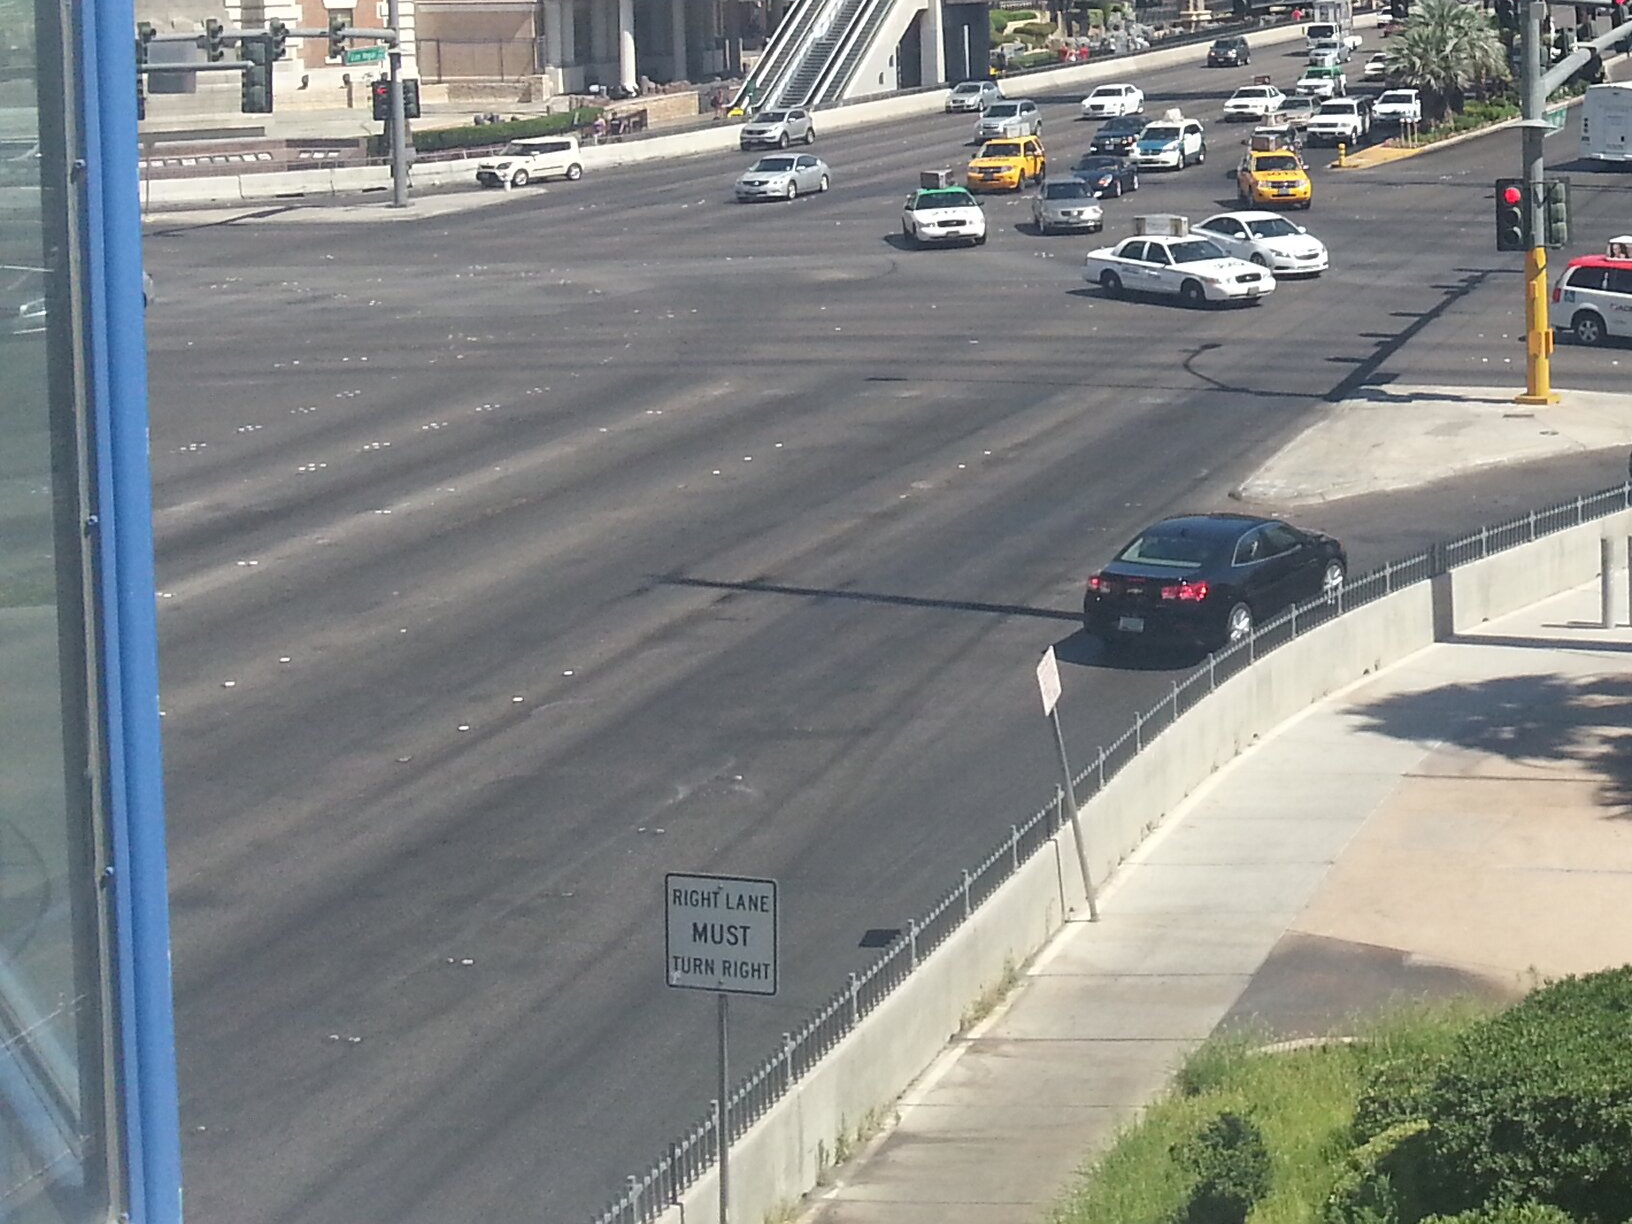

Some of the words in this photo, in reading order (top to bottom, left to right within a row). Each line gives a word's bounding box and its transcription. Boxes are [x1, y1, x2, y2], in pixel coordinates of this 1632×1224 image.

[672, 888, 720, 908] RIGHT
[726, 893, 770, 913] LANE
[692, 922, 751, 947] MUST
[672, 955, 715, 975] TURN
[722, 960, 771, 980] RIGHT
